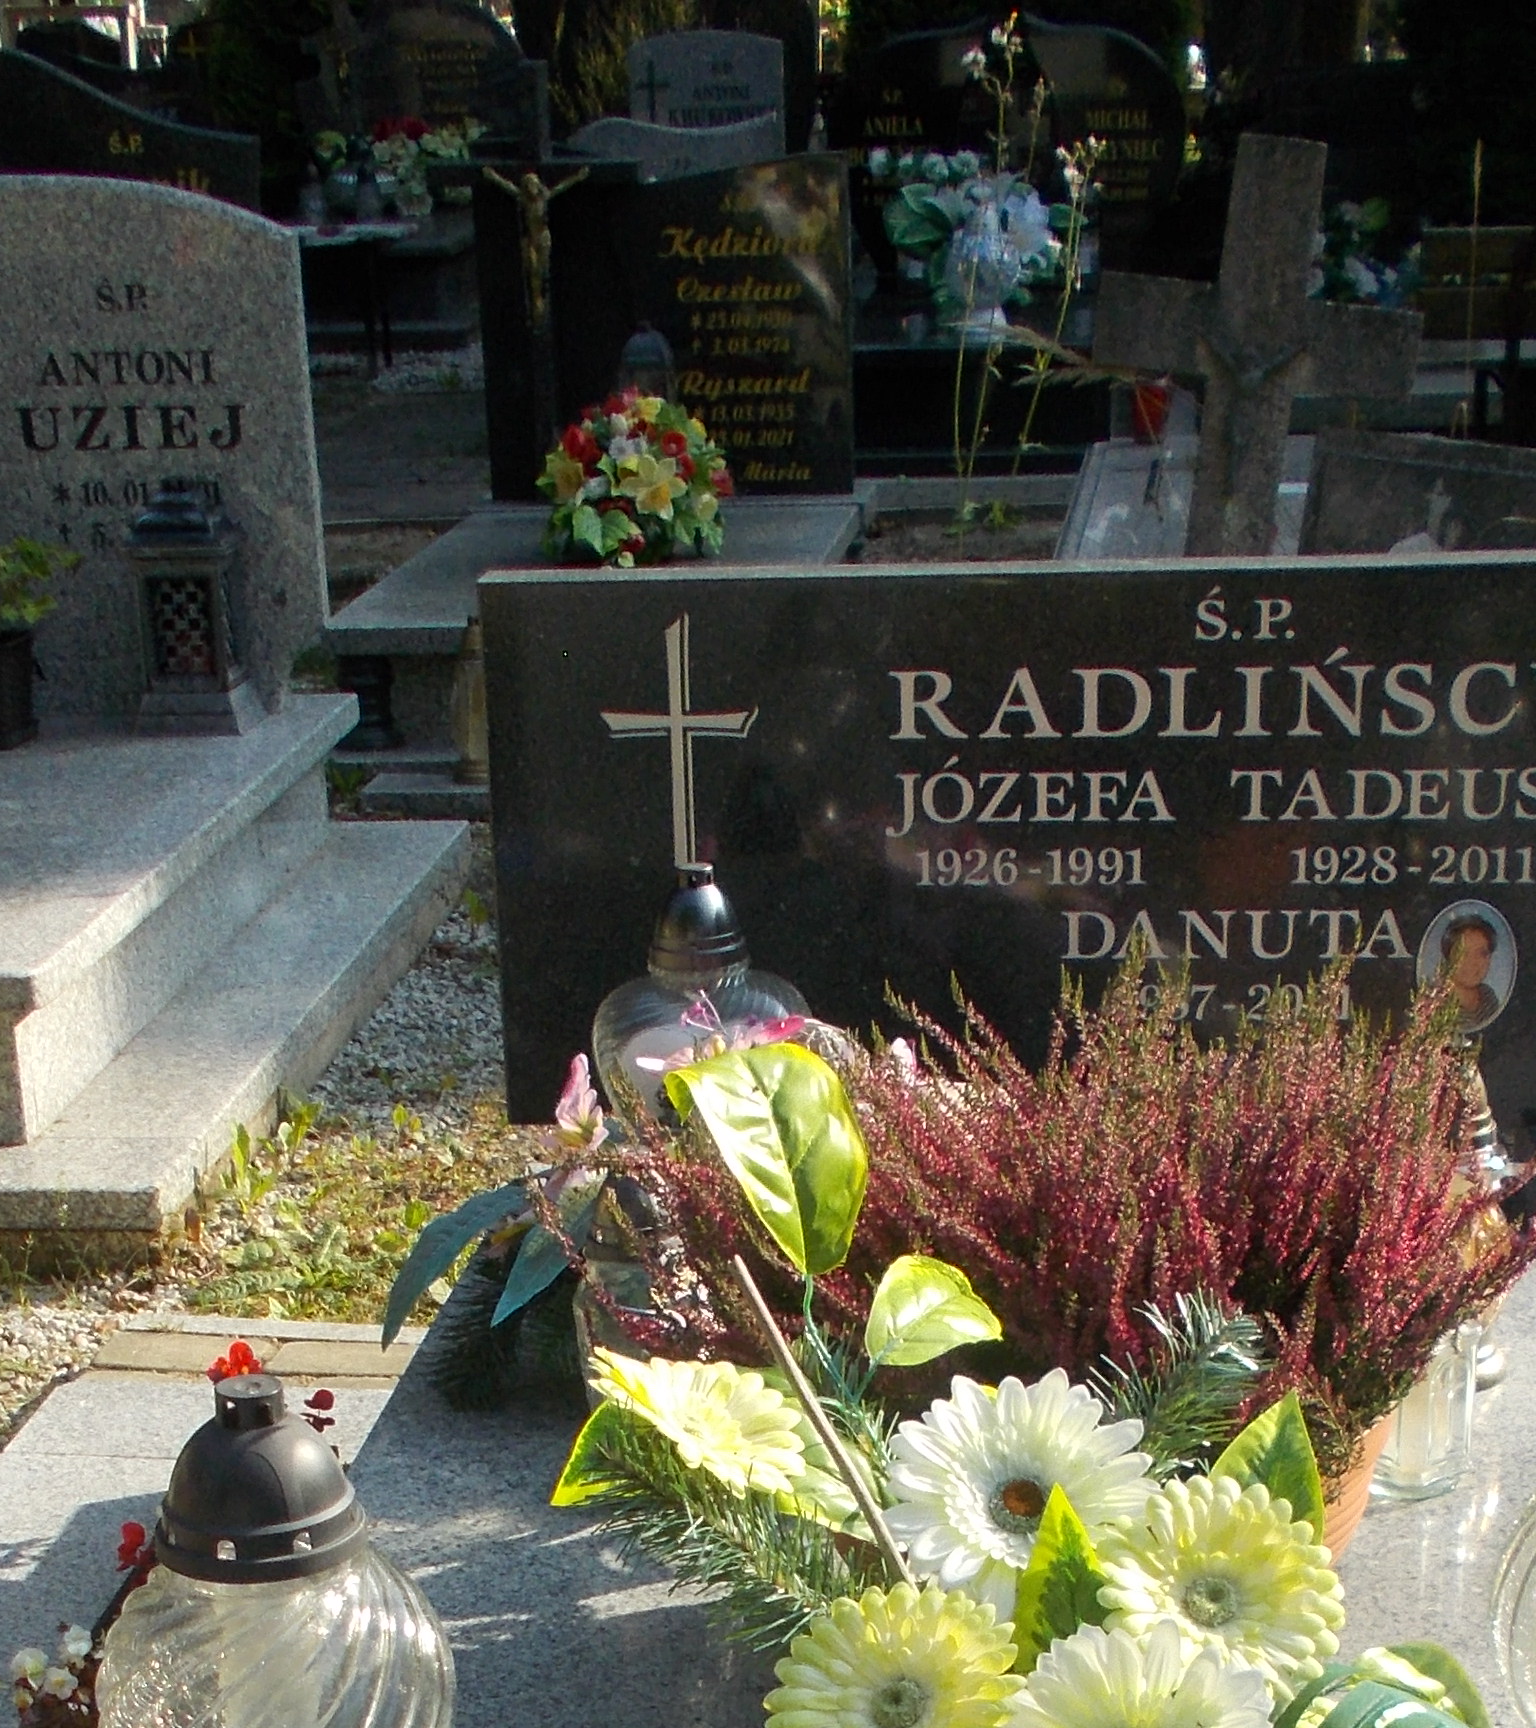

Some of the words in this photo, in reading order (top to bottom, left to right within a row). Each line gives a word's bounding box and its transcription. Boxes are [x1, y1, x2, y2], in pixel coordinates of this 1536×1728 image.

[39, 348, 218, 387] ANTONI
[677, 365, 811, 401] Ryszard
[14, 403, 247, 452] UZIEJ
[742, 460, 812, 483] Maria
[885, 756, 1178, 838] JÓZEFA
[1060, 907, 1414, 960] DANUTA
